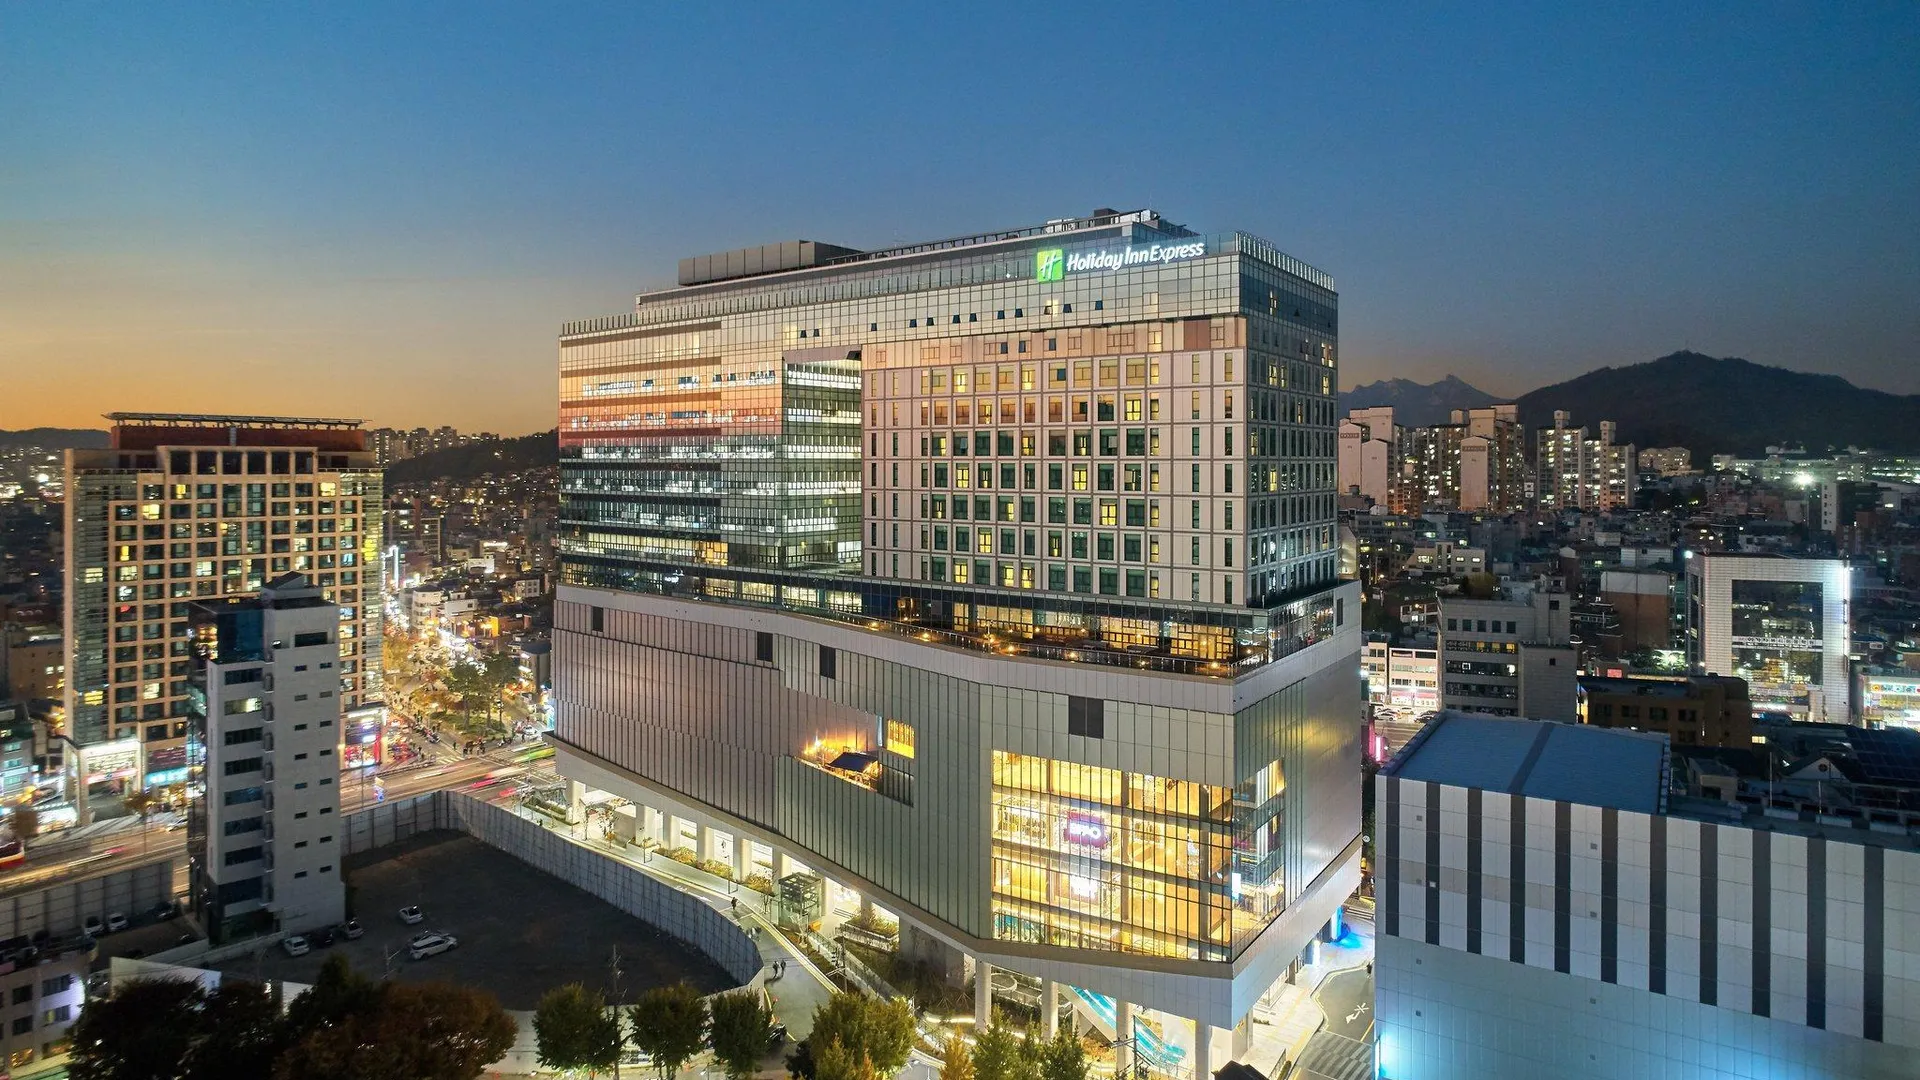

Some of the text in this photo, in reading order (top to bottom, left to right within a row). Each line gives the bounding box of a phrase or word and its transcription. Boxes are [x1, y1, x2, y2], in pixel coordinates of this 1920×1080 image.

[1066, 242, 1205, 271] Holiday Inn Express
